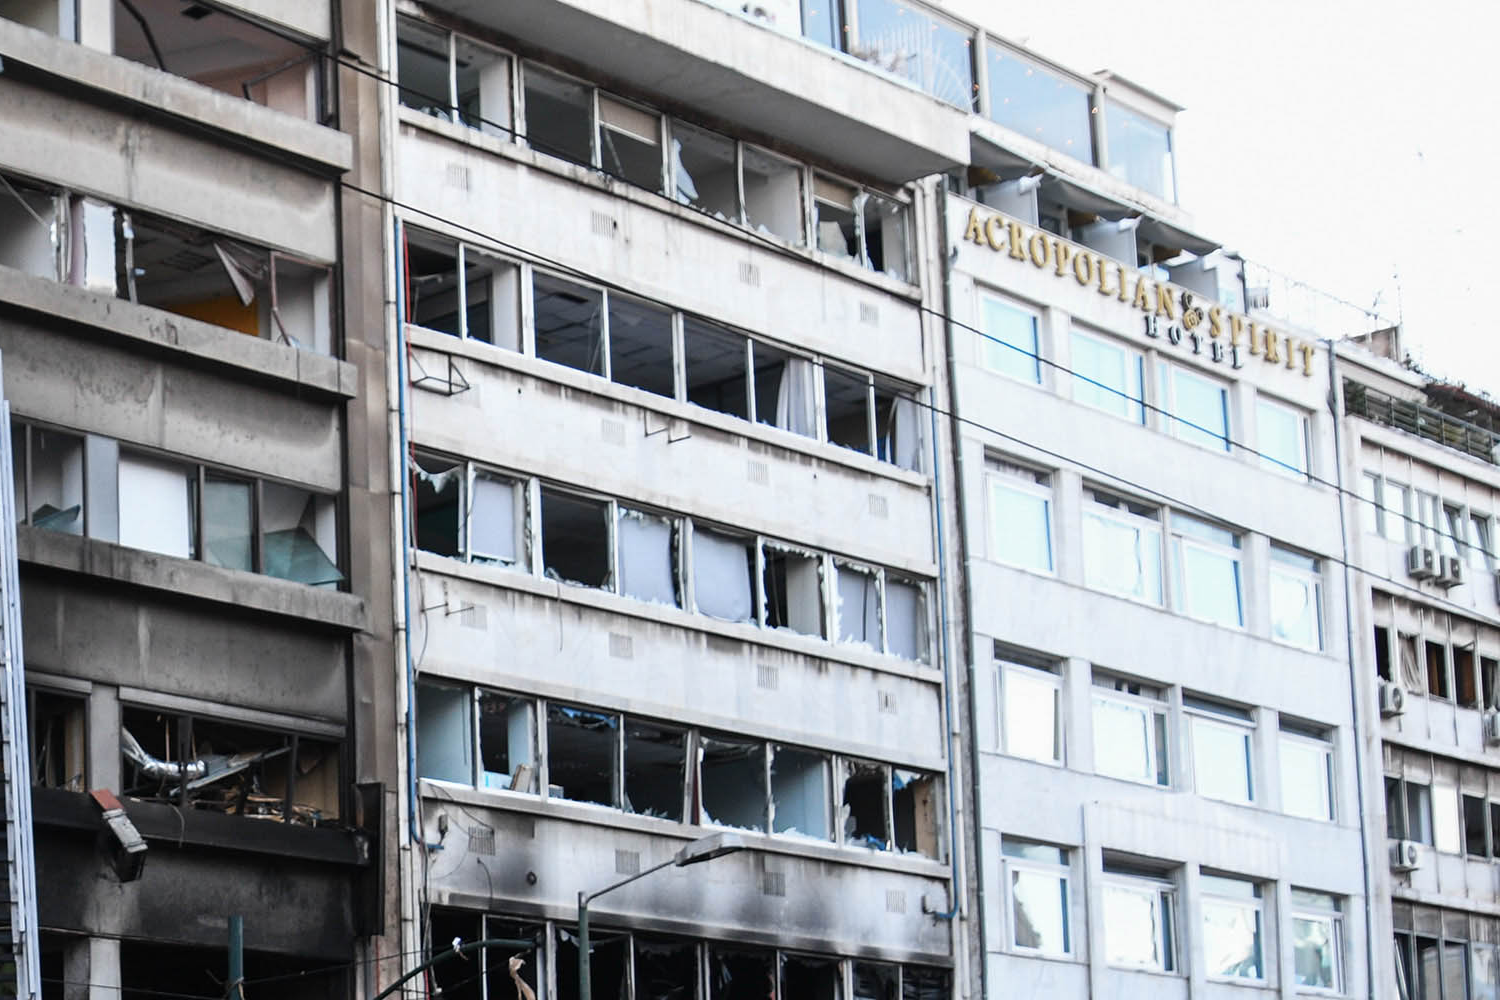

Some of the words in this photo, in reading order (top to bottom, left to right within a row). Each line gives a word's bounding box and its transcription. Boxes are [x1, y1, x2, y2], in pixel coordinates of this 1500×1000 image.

[964, 205, 1174, 320] ACROPOLIAN
[1208, 304, 1315, 377] SPIRIT
[1145, 315, 1243, 370] HOTEL
